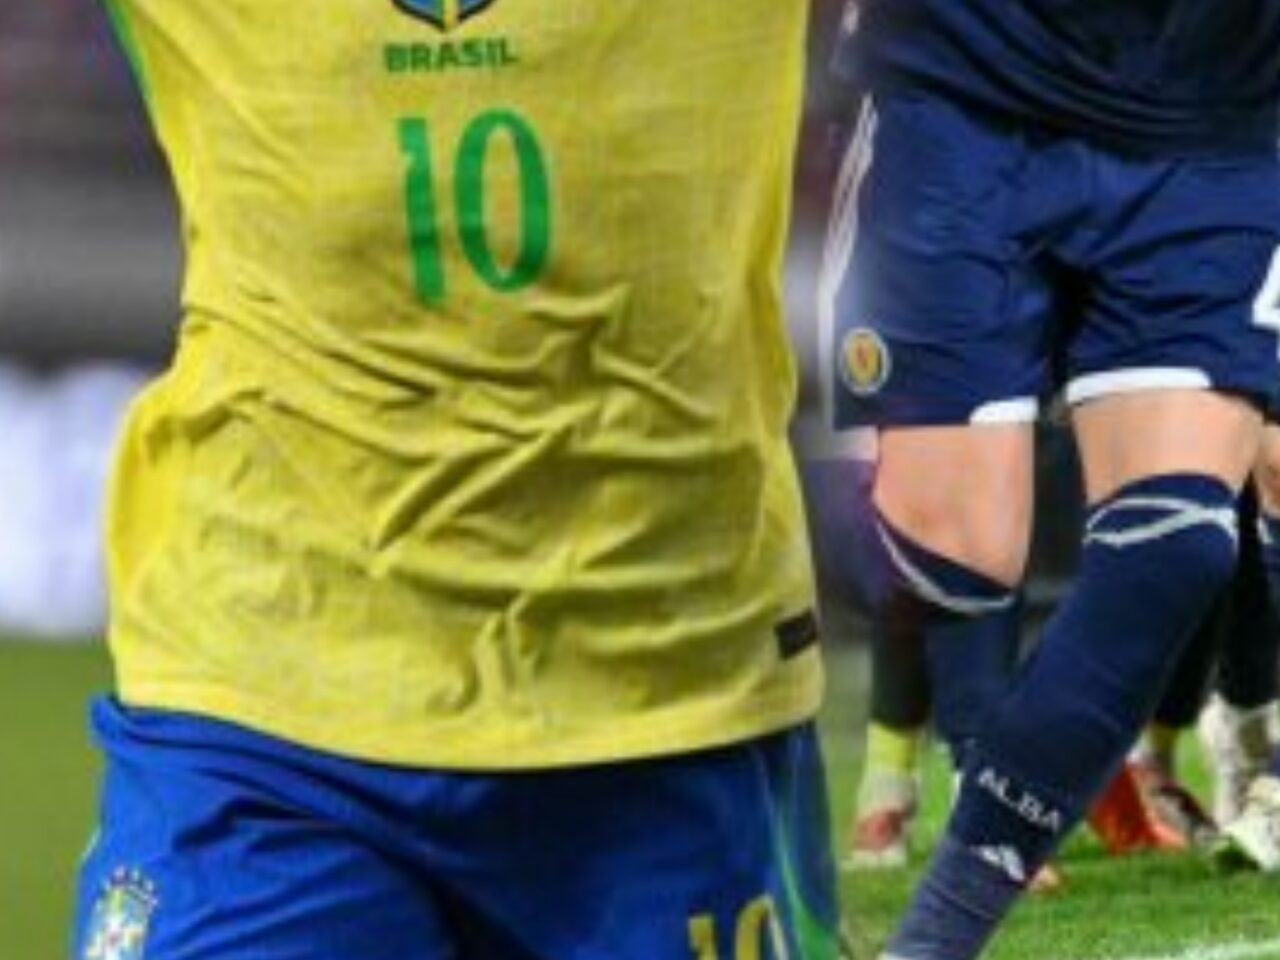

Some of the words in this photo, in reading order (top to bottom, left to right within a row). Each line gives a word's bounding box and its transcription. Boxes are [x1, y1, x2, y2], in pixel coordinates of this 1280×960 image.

[384, 38, 521, 74] BRASIL
[396, 106, 553, 313] 10
[978, 766, 1062, 835] ALBA
